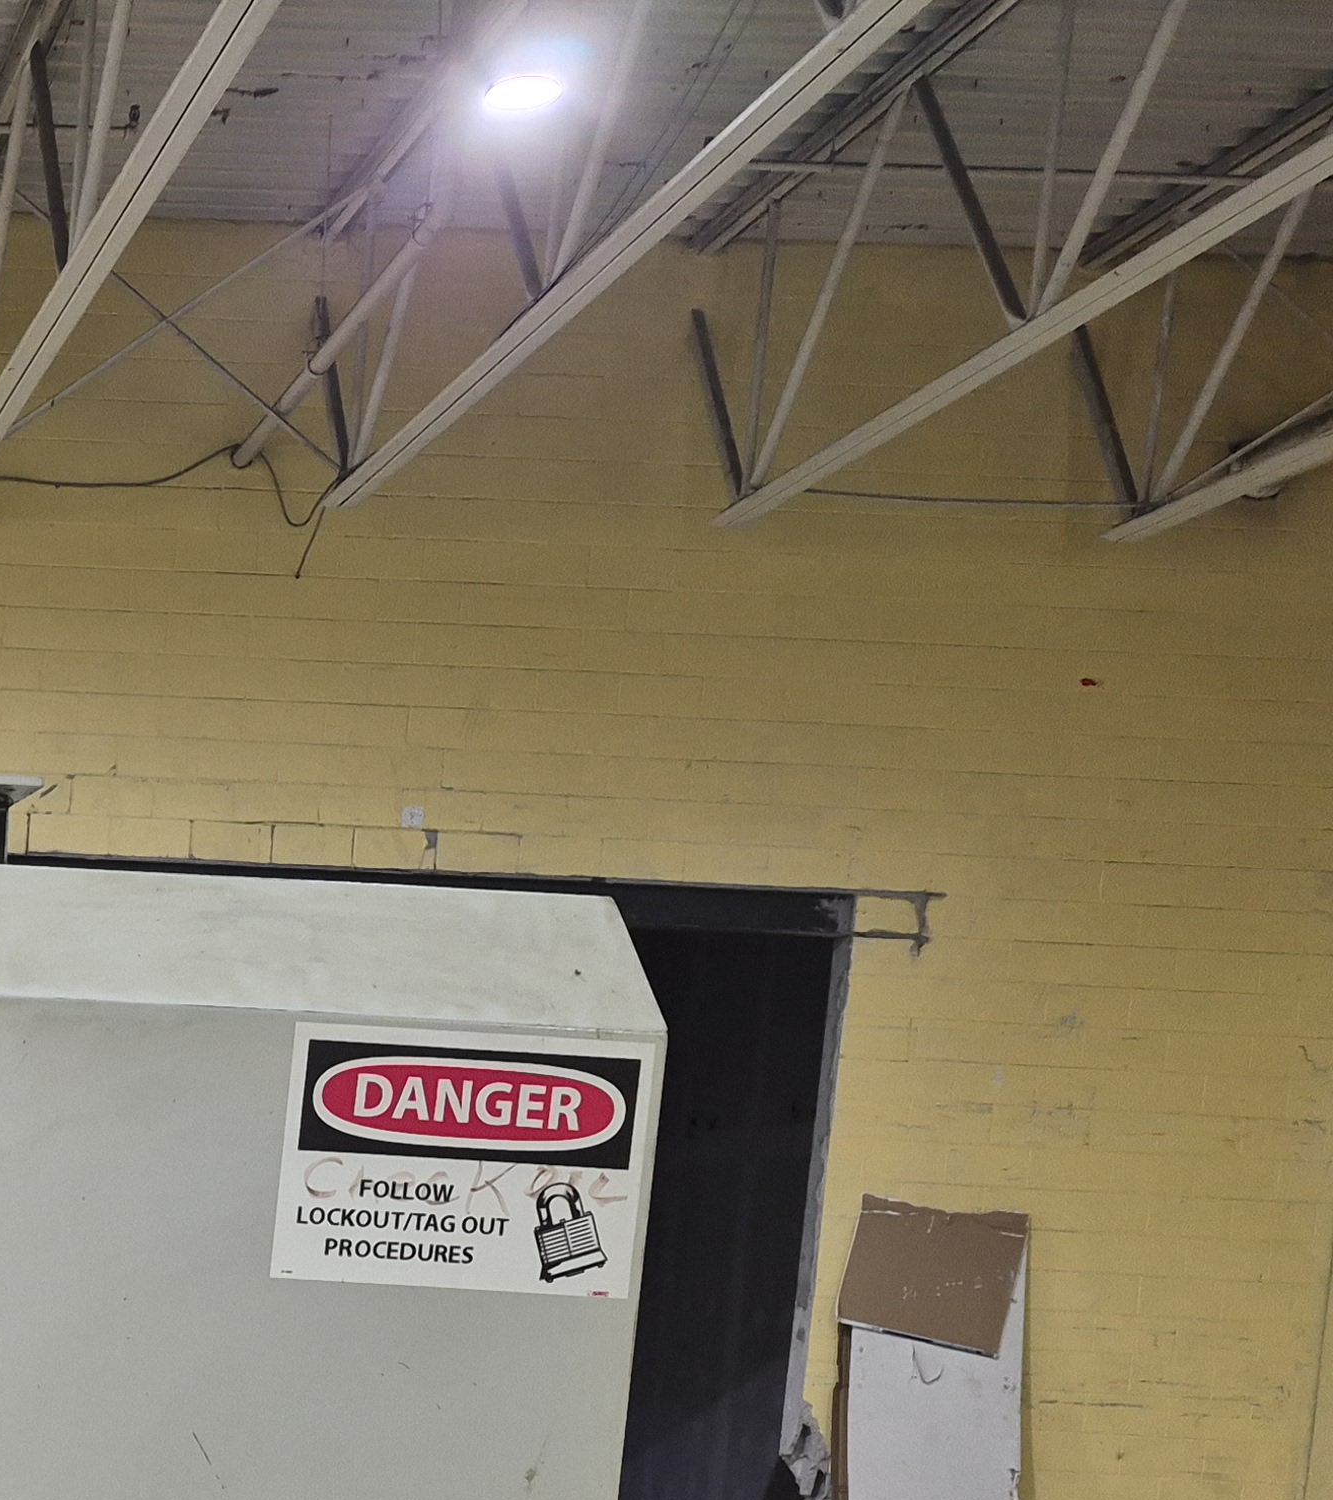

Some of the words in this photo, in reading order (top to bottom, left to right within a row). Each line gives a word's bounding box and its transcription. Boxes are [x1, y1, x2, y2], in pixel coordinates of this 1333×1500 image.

[353, 1073, 583, 1132] DANGER
[359, 1178, 455, 1203] FOLLOW
[296, 1206, 457, 1235] LOCKOUT/TAG
[461, 1216, 510, 1237] OUT
[324, 1238, 475, 1265] PROCEDURES
